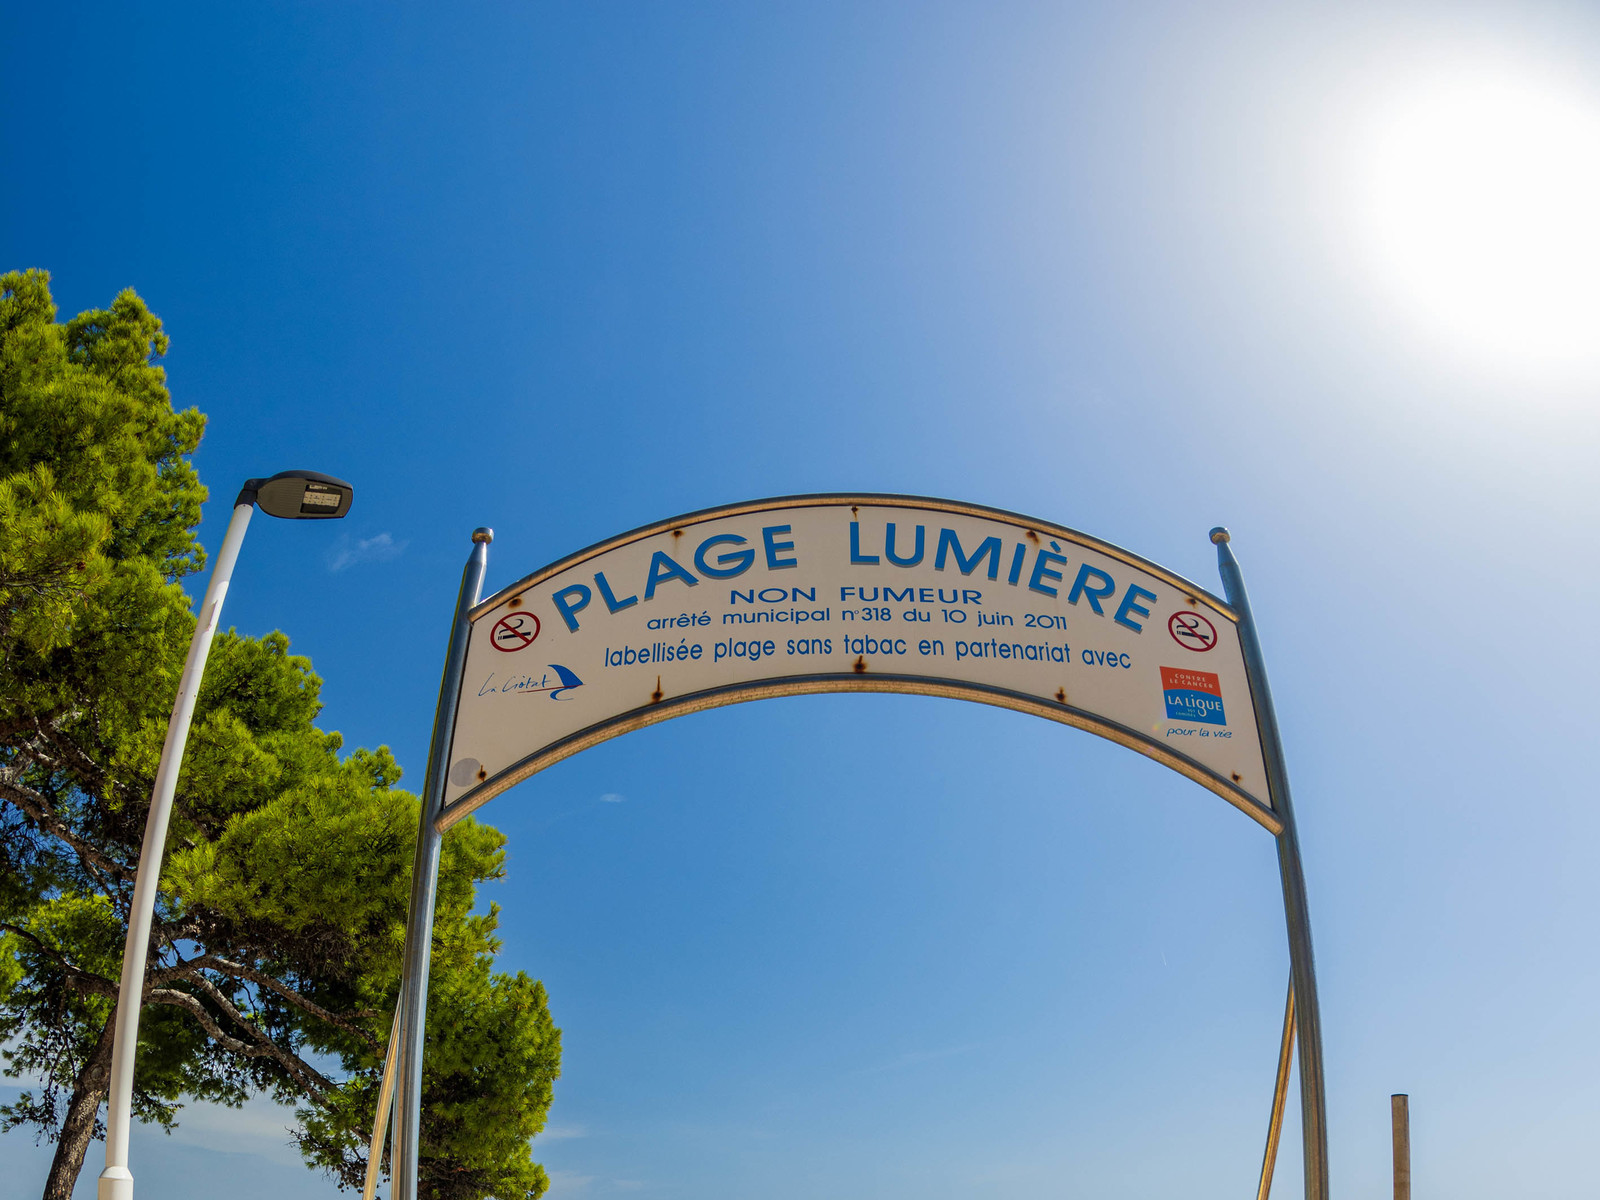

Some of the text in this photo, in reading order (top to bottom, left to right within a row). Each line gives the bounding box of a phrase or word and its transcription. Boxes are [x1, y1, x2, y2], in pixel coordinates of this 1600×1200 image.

[552, 521, 1158, 634] PLAGE LUMIÈRE
[731, 587, 983, 605] NON FUMEUR
[647, 610, 712, 630] arrêté
[722, 607, 830, 625] municipal
[903, 608, 931, 622] du
[941, 609, 967, 624] 10
[977, 610, 1014, 627] juin
[1025, 613, 1067, 630] 2011
[604, 634, 1131, 669] labellisée plage sans tabac en partenariat avec
[478, 672, 496, 697] La
[1174, 673, 1206, 682] CONTRE
[1182, 679, 1213, 689] CANCER
[1167, 695, 1184, 706] LA
[1166, 728, 1233, 739] pour la vie
